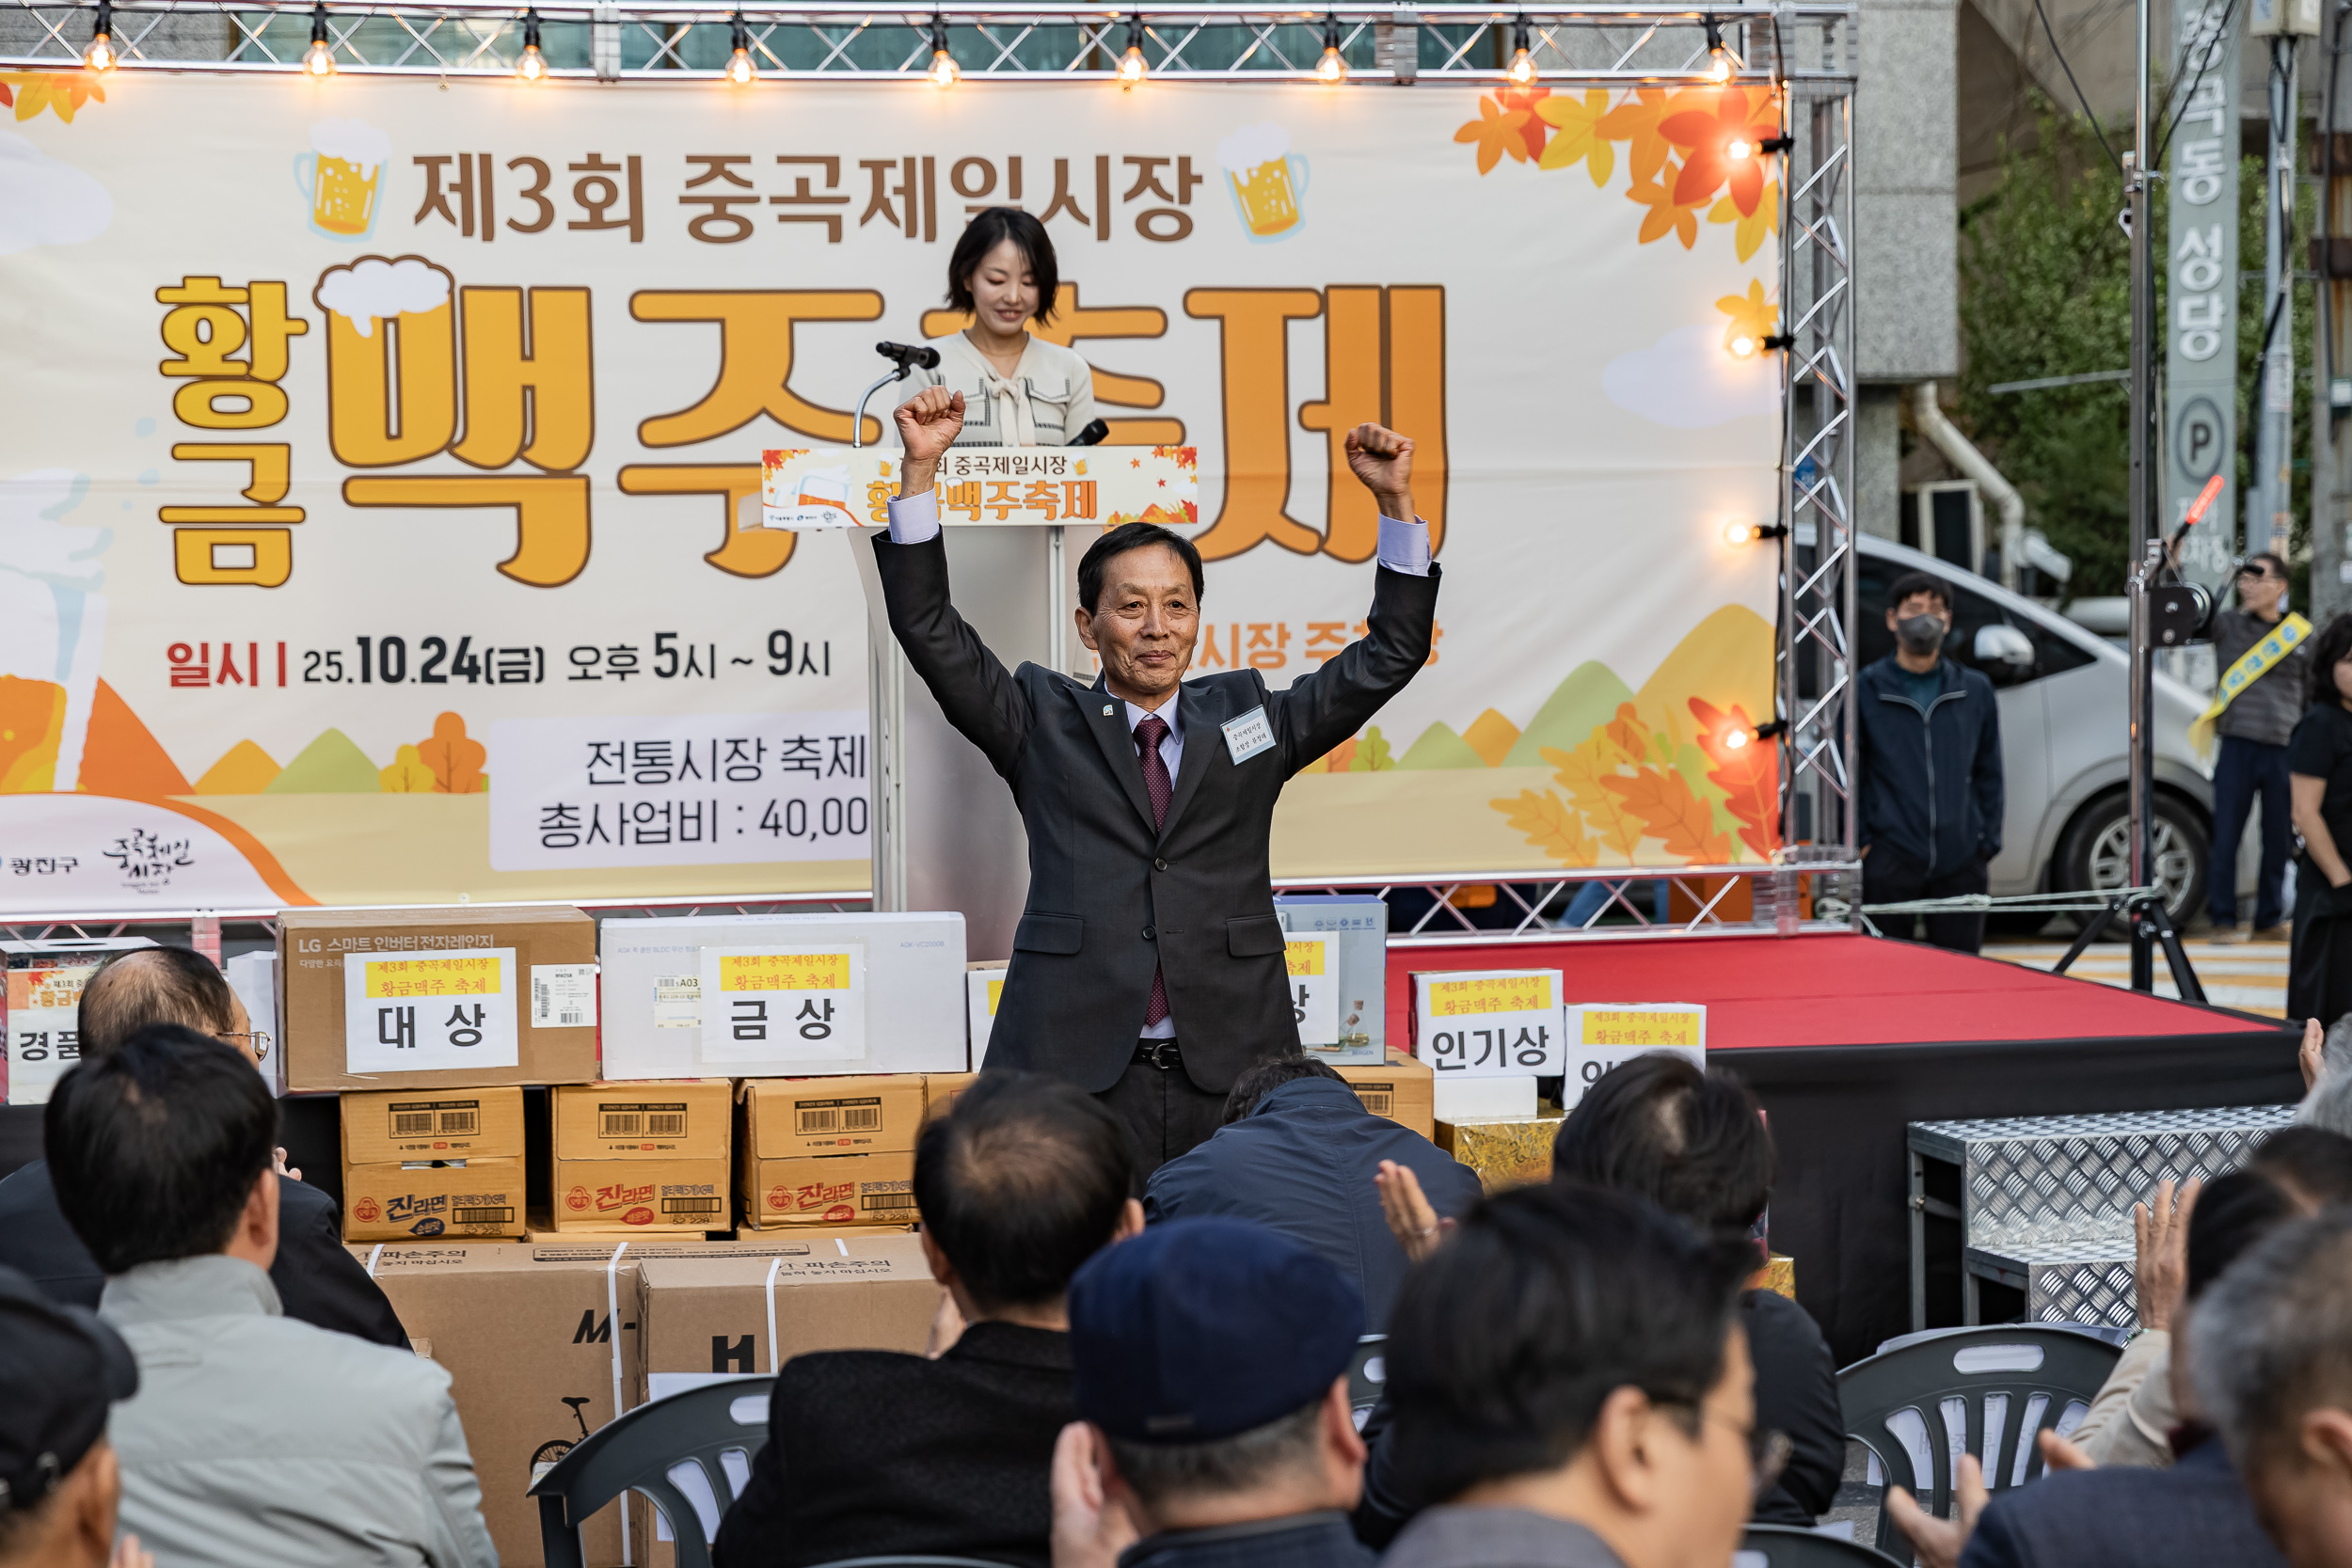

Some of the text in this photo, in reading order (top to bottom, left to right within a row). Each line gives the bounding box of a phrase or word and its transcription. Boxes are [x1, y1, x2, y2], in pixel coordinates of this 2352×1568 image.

[412, 152, 1203, 244] 제3회 중곡제일시장
[2175, 223, 2229, 362] 성당
[155, 276, 309, 589] 황금
[954, 455, 1068, 476] 중곡제일시장
[866, 478, 1098, 522] 황맥주축제
[167, 641, 258, 688] 일시
[302, 635, 545, 686] 25.10.24(금)
[567, 643, 640, 681] 오후
[653, 631, 715, 679] 5시
[767, 629, 831, 677] 9시
[1190, 622, 1292, 671] 시장
[586, 734, 866, 786] 전통시장 축제
[539, 801, 719, 848] 총사업비
[10, 857, 79, 876] 광진구
[298, 933, 495, 953] LG 스마트 인버터 전자레인지
[377, 958, 489, 974] 제3회 중곡제일시장
[731, 954, 839, 968] 제3회 중곡제일시장
[380, 977, 487, 997] 황금맥주 축제
[734, 973, 835, 991] 황금맥주 축제
[1439, 976, 1540, 993] 제3회 중곡제일시장
[731, 998, 835, 1040] 금 상
[1443, 994, 1538, 1016] 황금맥주 축제
[1593, 1012, 1690, 1023] 제3회 중곡제일시장
[377, 1004, 485, 1049] 대 상
[1596, 1029, 1687, 1046] 황금맥주 축제
[1432, 1025, 1549, 1072] 인기상
[385, 1194, 449, 1224] 진라면
[595, 1183, 656, 1212] 진라면
[796, 1181, 855, 1211] 진라면
[380, 1249, 467, 1259] 파손주의
[803, 1259, 892, 1269] 파손주의
